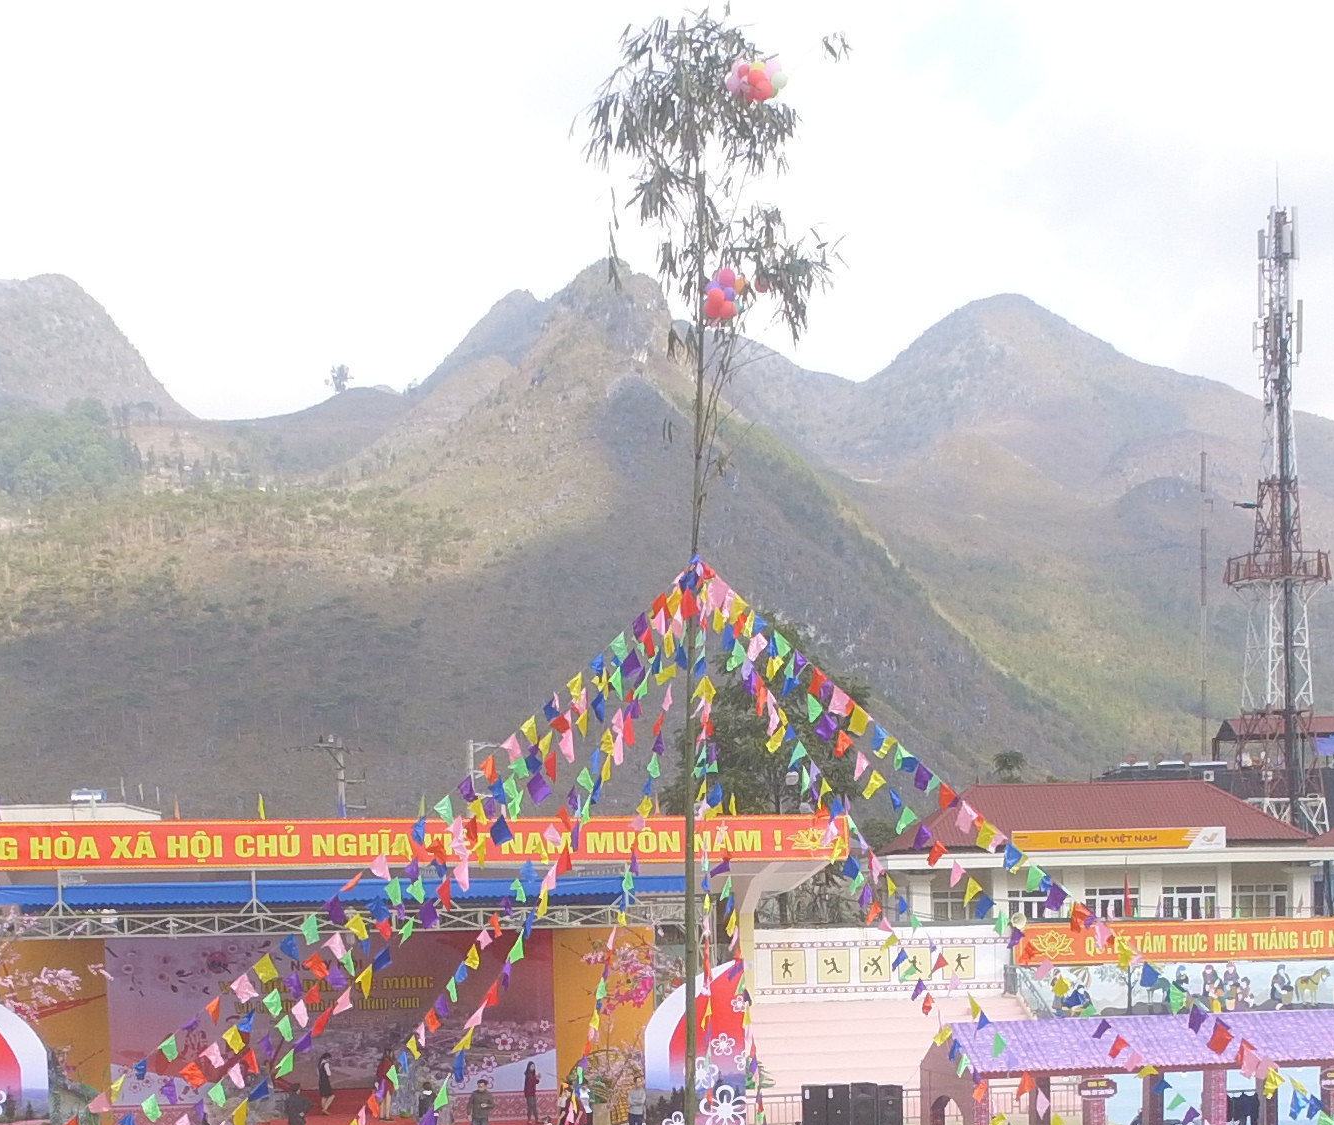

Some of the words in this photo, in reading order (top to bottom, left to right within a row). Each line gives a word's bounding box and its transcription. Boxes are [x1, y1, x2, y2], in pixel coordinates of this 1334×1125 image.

[30, 830, 100, 860] HÒA
[110, 830, 157, 859] XÃ
[167, 830, 223, 863] HỘI
[234, 825, 300, 858] CHỦ
[586, 826, 681, 854] MUÔN
[1111, 832, 1133, 844] VIỆT
[1135, 833, 1158, 843] NAM
[1135, 931, 1167, 953] TÂM
[1170, 931, 1208, 957] THỰC
[1214, 929, 1248, 956] HIỆN
[1302, 928, 1325, 953] LỢI
